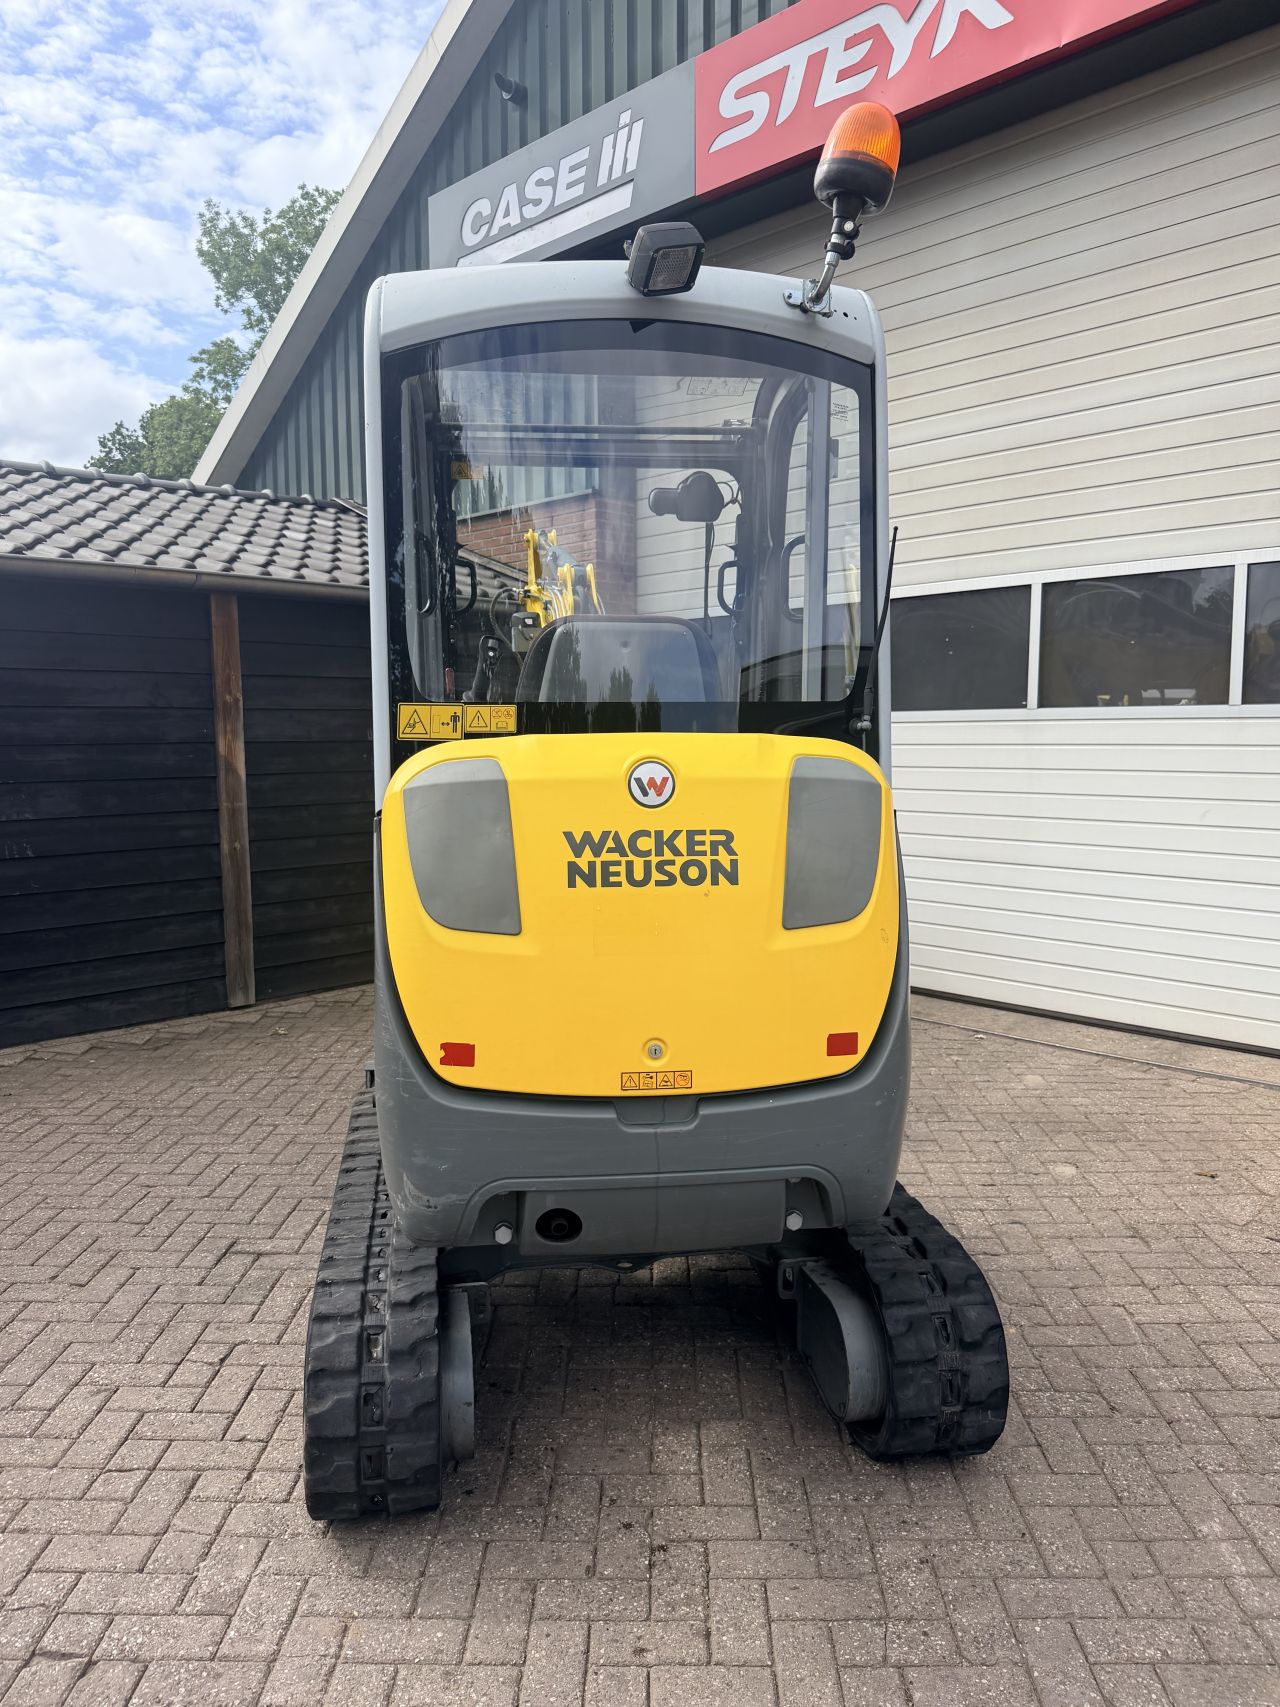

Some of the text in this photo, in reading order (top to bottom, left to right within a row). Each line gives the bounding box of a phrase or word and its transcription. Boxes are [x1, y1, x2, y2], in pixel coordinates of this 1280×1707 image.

[460, 145, 591, 247] CASE
[562, 829, 739, 859] WACKER
[567, 858, 739, 889] NEUSON
